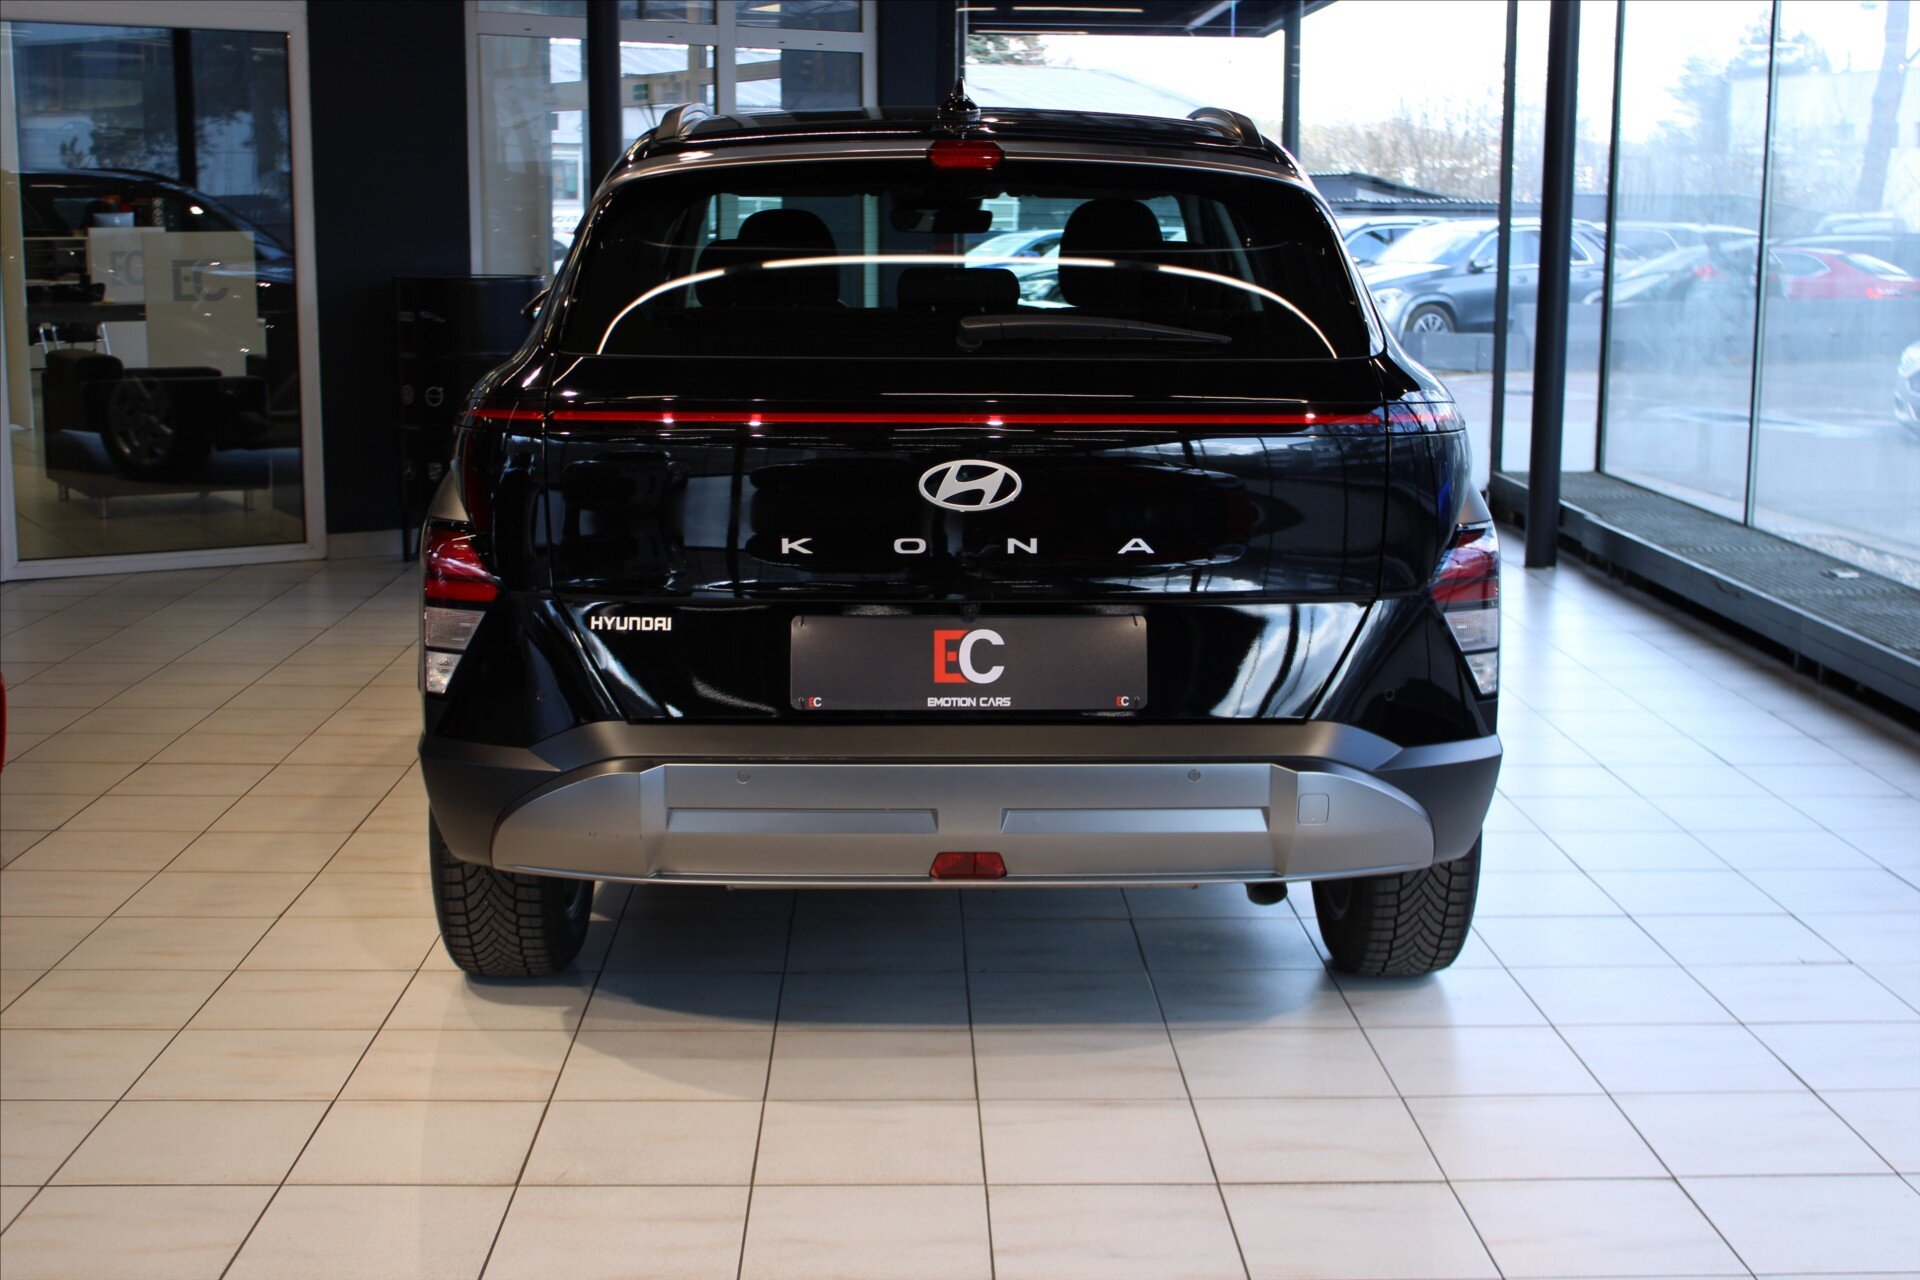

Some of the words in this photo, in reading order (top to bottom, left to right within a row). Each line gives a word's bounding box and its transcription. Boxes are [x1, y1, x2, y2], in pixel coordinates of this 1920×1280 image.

[172, 259, 229, 302] EC
[590, 616, 672, 631] HYUNDAI
[933, 629, 1005, 684] EC
[808, 696, 822, 708] EC
[927, 697, 977, 707] EMOTION
[980, 697, 1011, 707] CARS
[1115, 695, 1130, 708] EC
